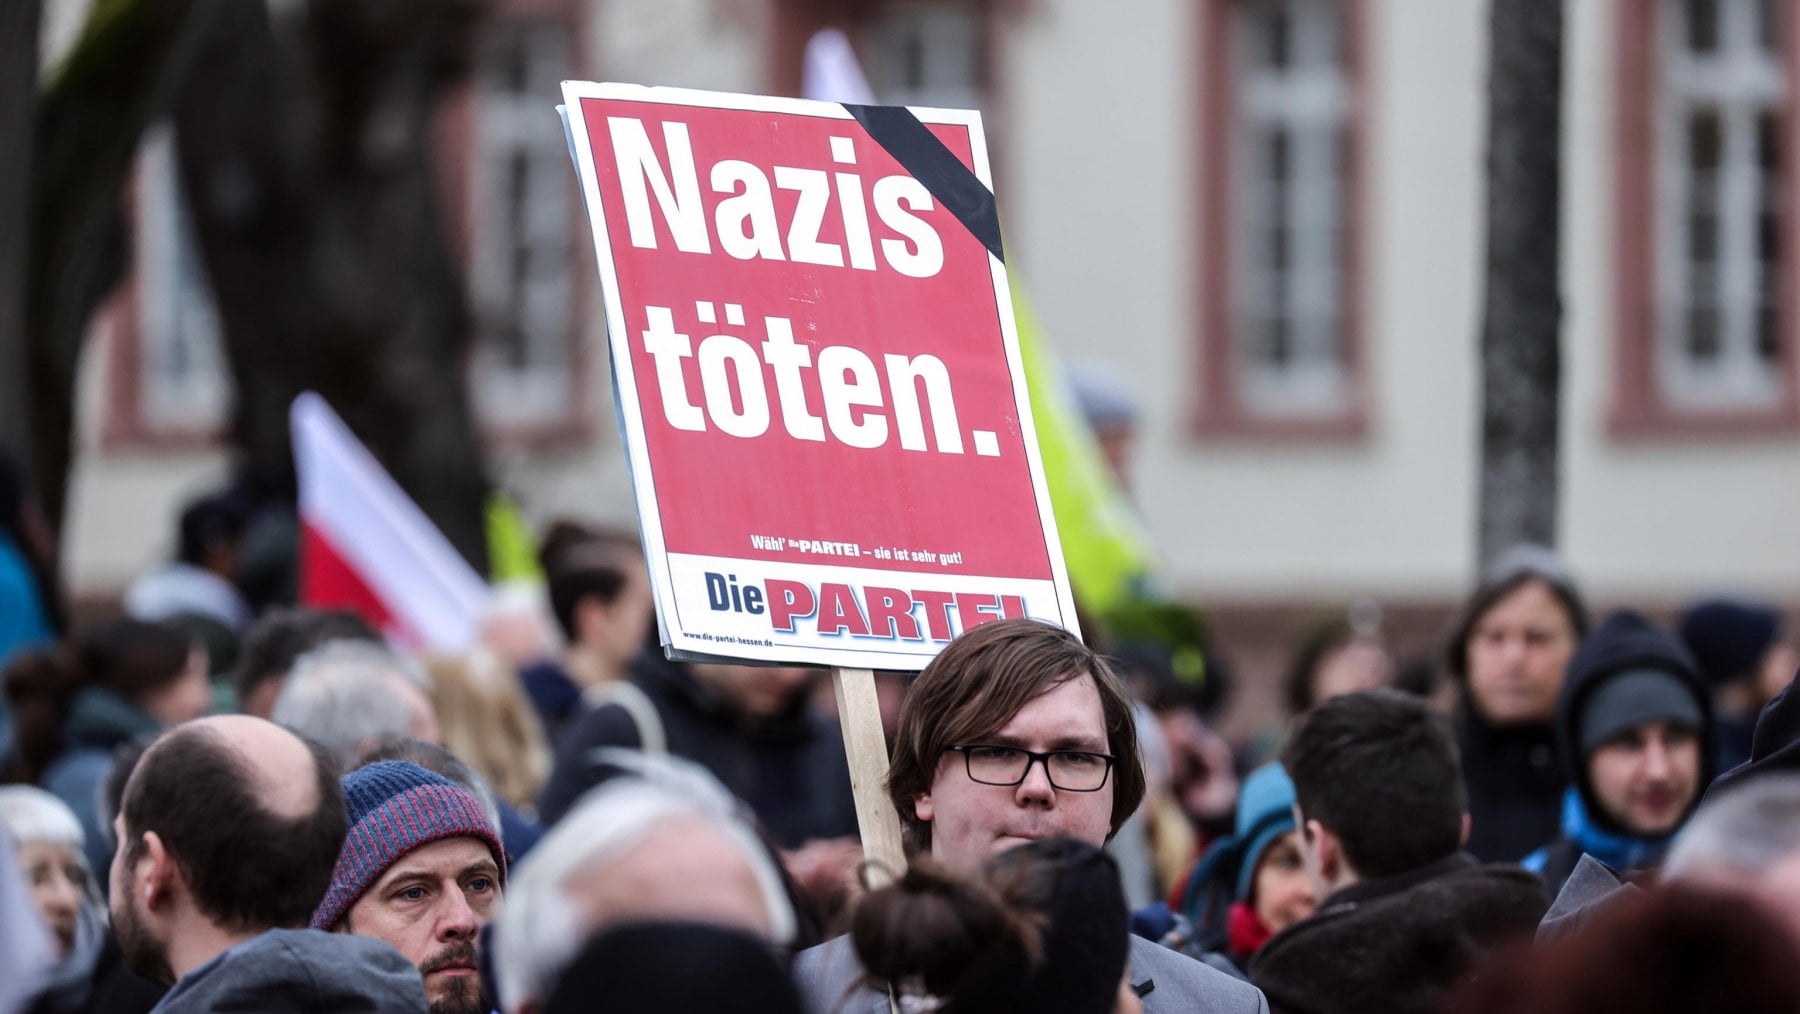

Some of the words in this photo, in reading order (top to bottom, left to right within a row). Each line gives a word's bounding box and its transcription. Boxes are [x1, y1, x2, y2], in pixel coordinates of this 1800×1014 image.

[607, 116, 945, 278] Nazis
[642, 301, 1001, 456] töten.
[799, 540, 860, 556] PARTEI
[874, 546, 892, 559] sie
[893, 547, 910, 561] ist
[911, 550, 936, 563] sehr
[940, 551, 963, 566] gut!
[704, 571, 765, 615] Die
[683, 632, 773, 647] www.die-partei-hessen.de
